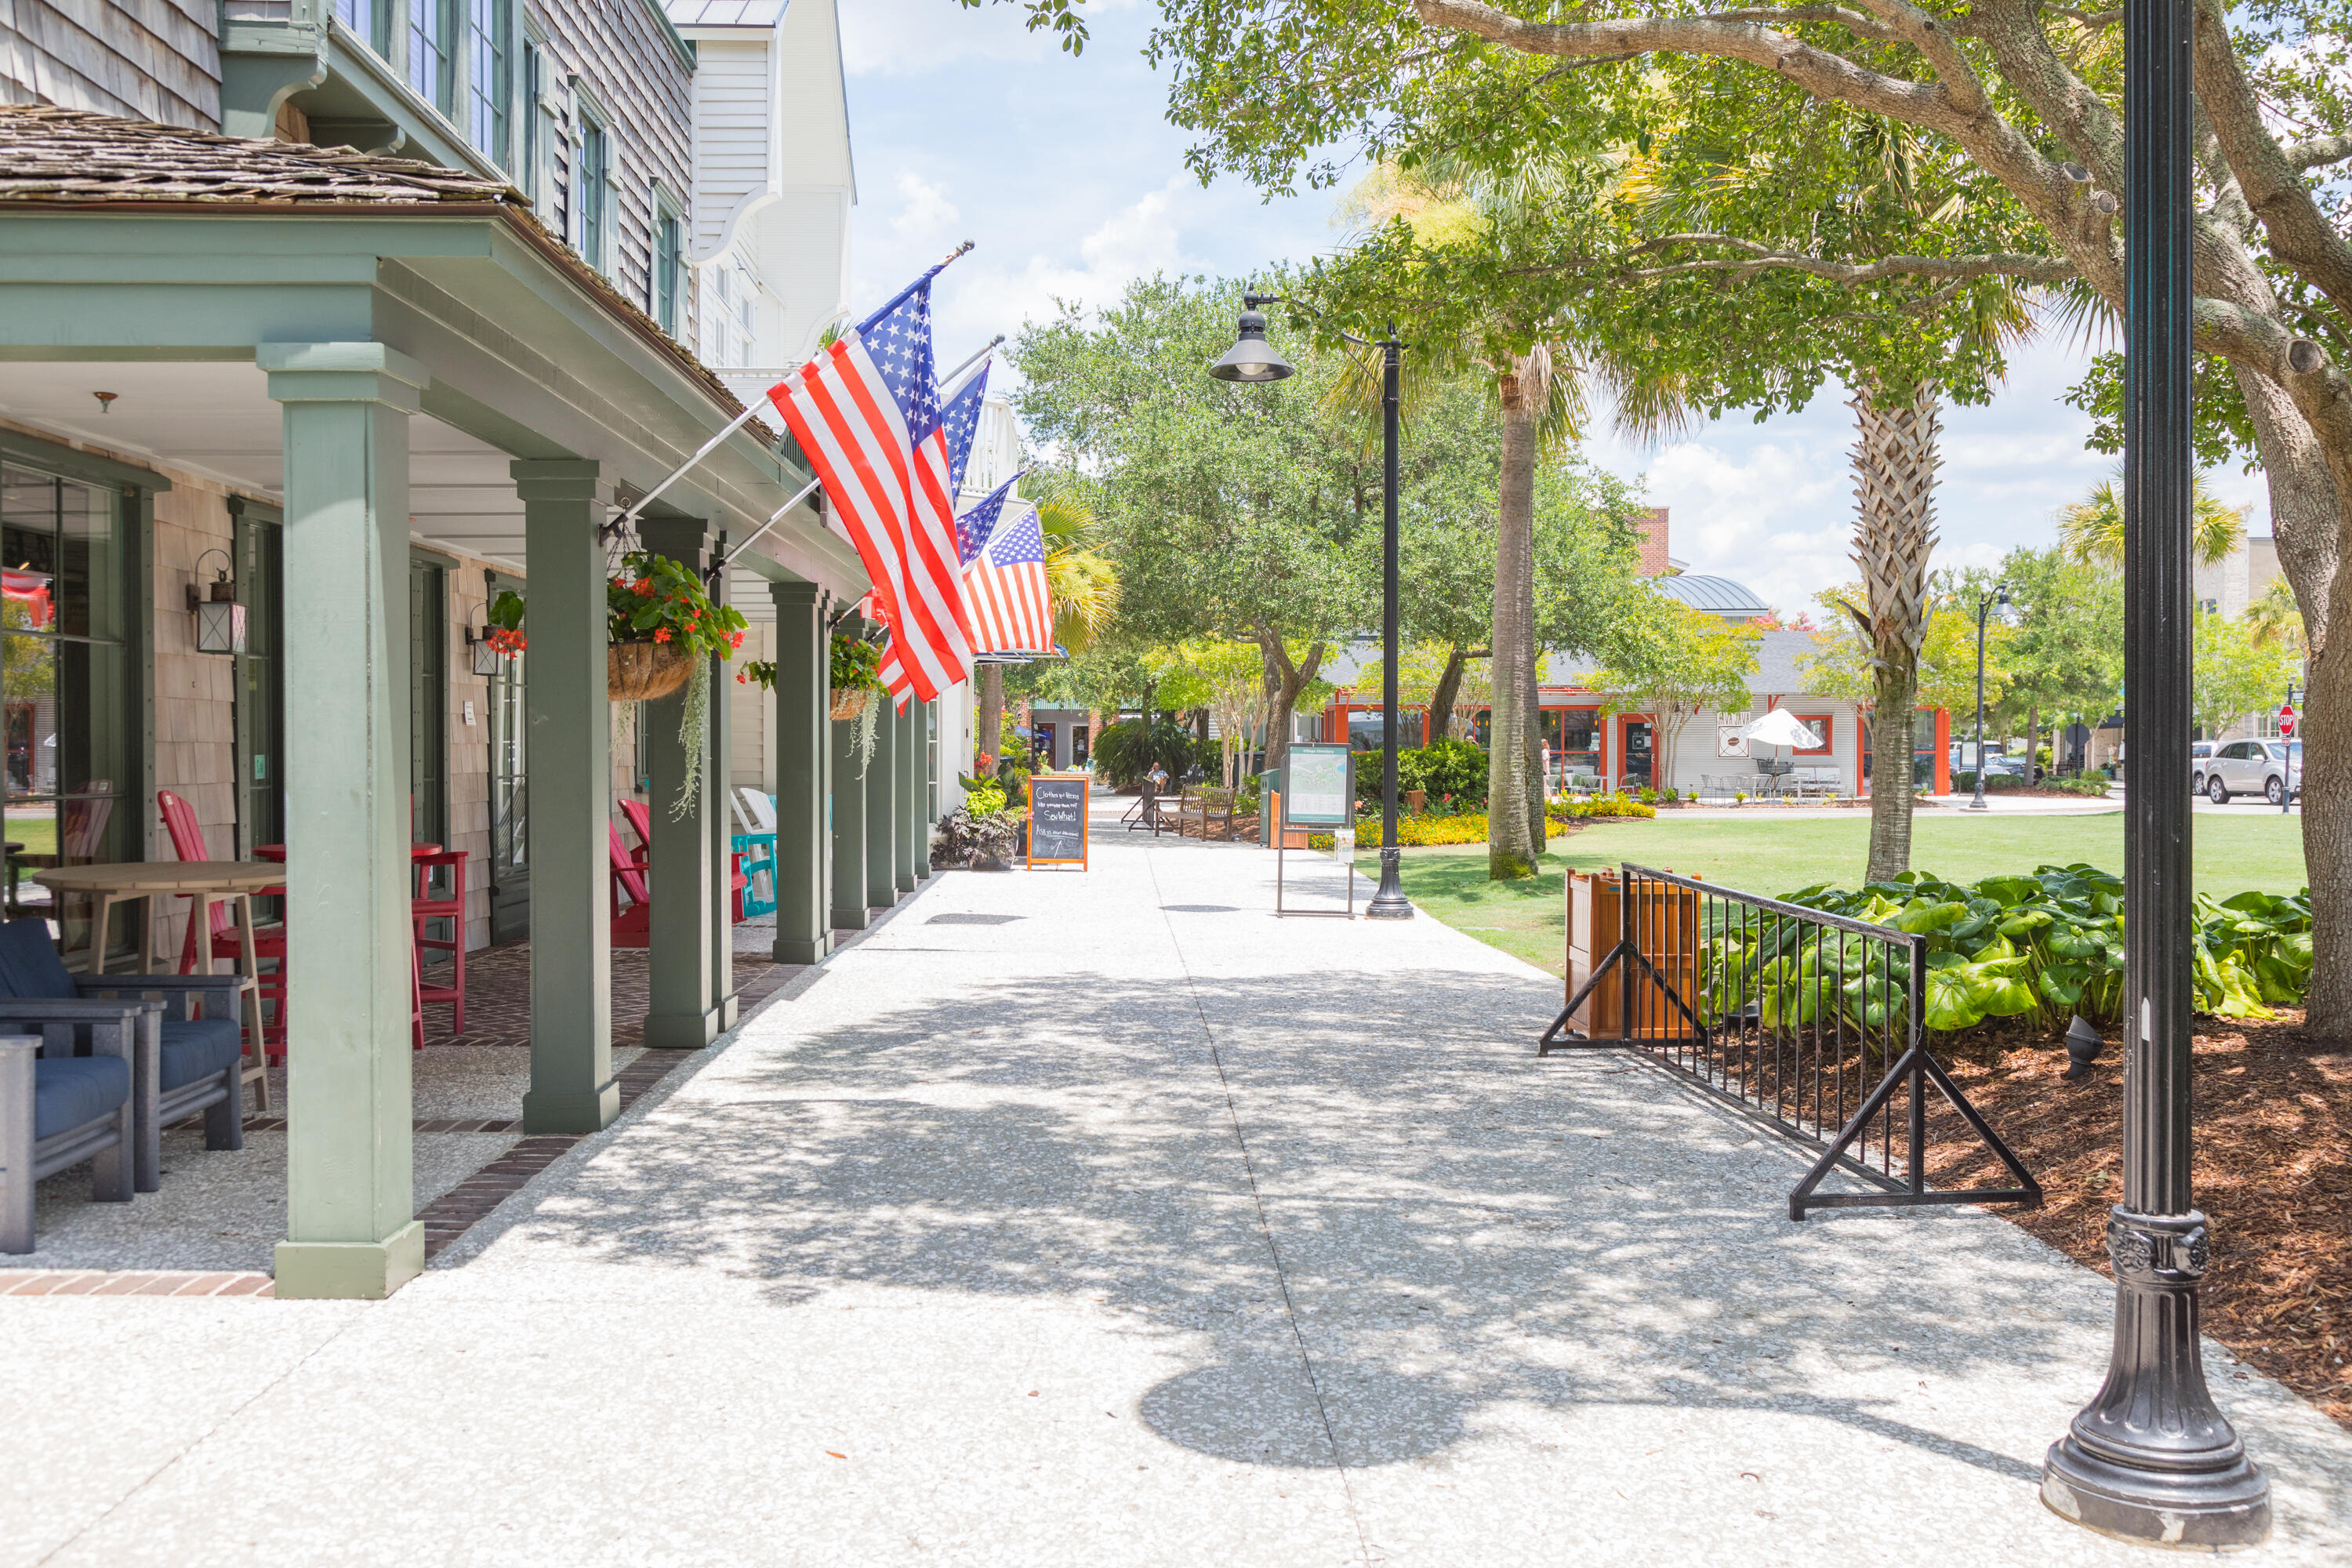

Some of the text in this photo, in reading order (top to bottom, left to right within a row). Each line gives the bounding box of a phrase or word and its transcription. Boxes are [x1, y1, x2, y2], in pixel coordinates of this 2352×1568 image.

[1735, 711, 1750, 725] JAVA
[2279, 714, 2293, 726] STOP
[1036, 786, 1058, 800] Clothes
[1044, 810, 1076, 821] Sew What!
